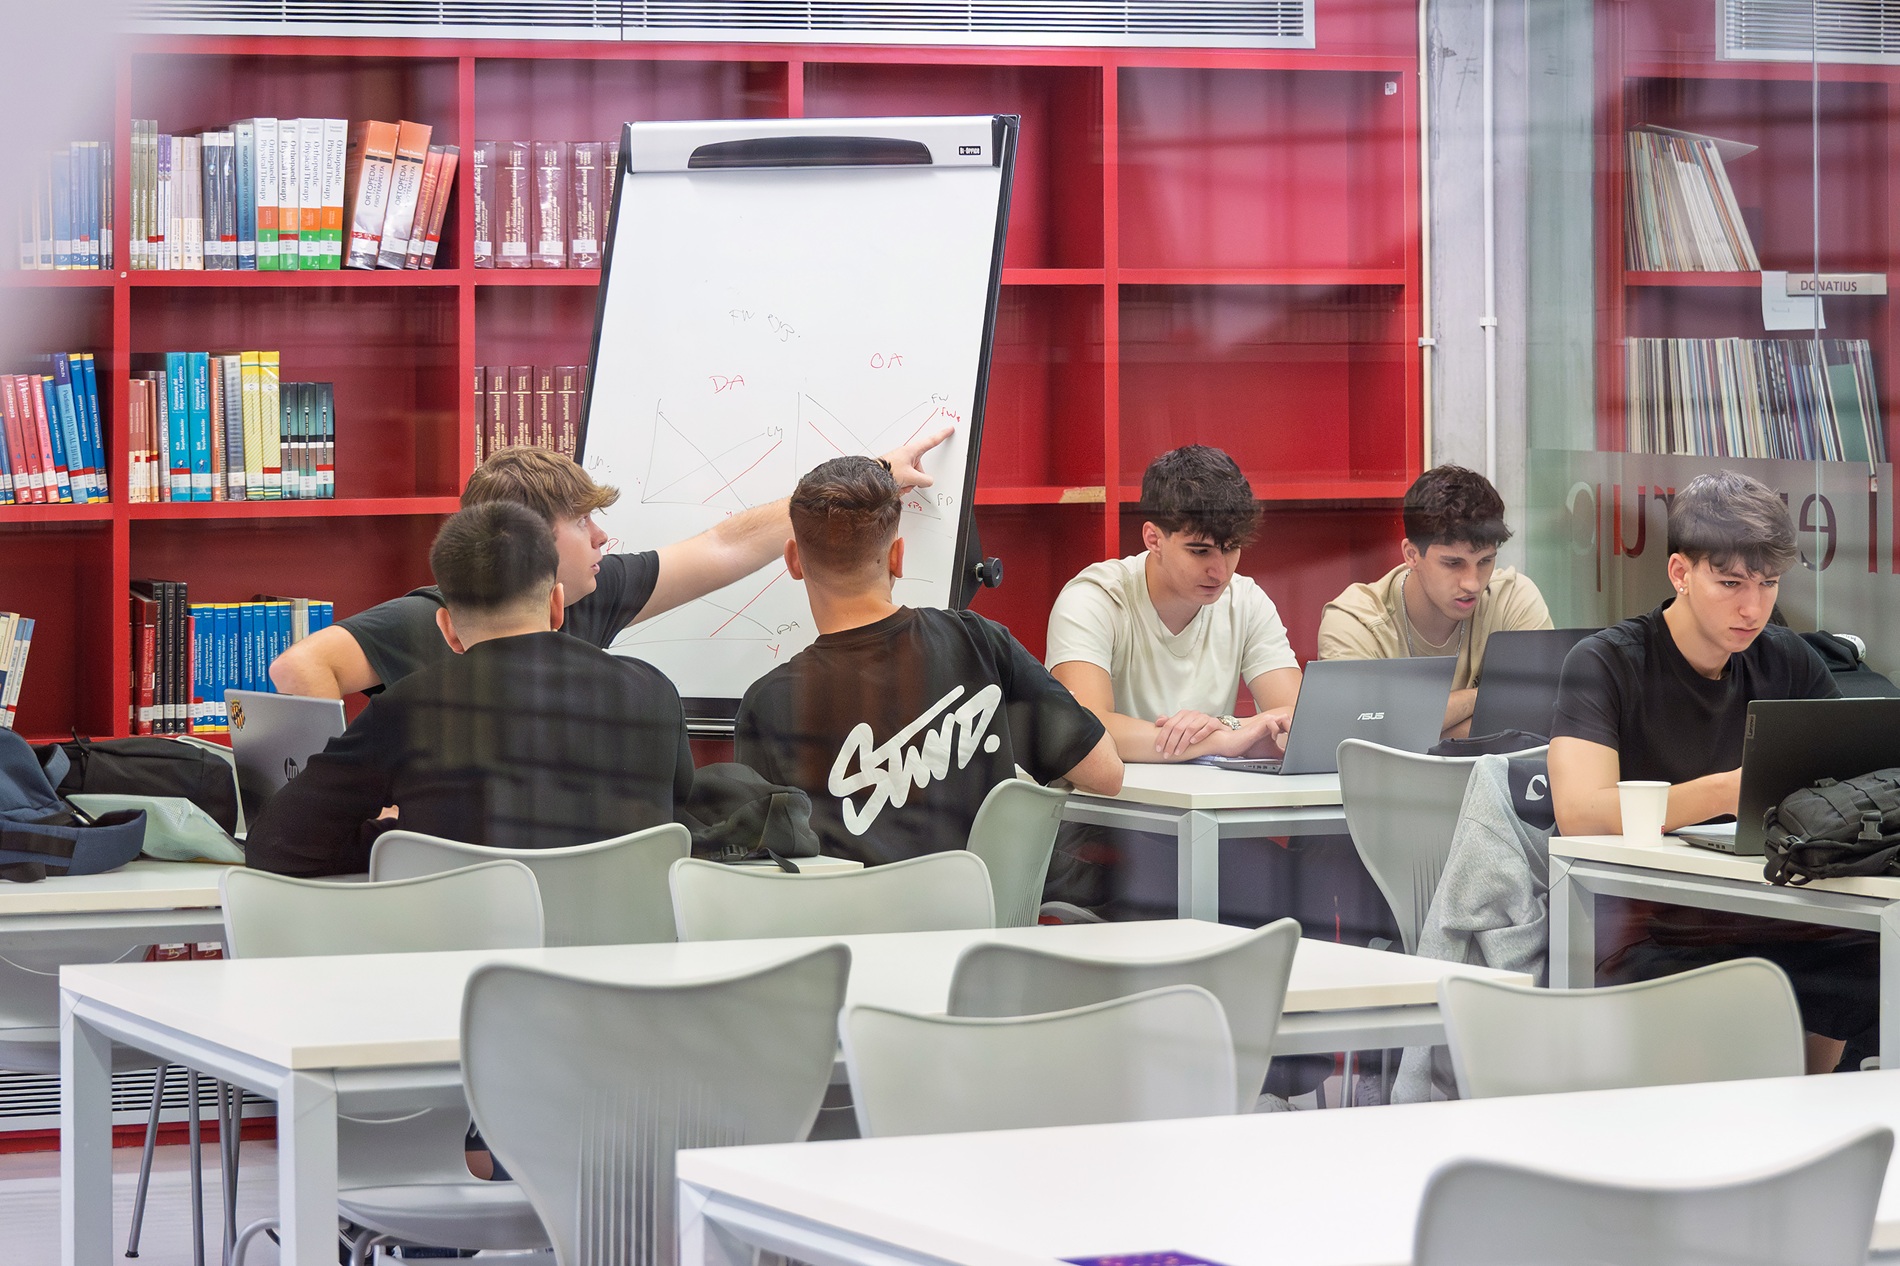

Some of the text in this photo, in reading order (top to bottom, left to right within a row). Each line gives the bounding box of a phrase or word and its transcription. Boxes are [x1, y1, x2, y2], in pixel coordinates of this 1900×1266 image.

[259, 140, 267, 200] Physical Therapy
[268, 139, 276, 185] Orthopaedic
[289, 140, 297, 186] Orthopaedic
[302, 141, 311, 202] Physical Therapy
[312, 141, 320, 187] Orthopaedic
[324, 140, 334, 200] Physical Therapy
[335, 140, 344, 186] Orthopaedic
[365, 164, 376, 206] ORTOPEDIA
[395, 164, 408, 206] ORTOPEDIA
[1800, 280, 1857, 292] DONATIUS
[870, 352, 903, 369] OA
[6, 384, 15, 418] Fisioterapia
[36, 384, 44, 418] Fisioterapia
[708, 374, 745, 394] DA
[66, 415, 76, 445] PHYSICAL
[94, 414, 102, 449] Rehabilitación
[767, 426, 783, 439] LM
[1357, 712, 1385, 720] ASUS
